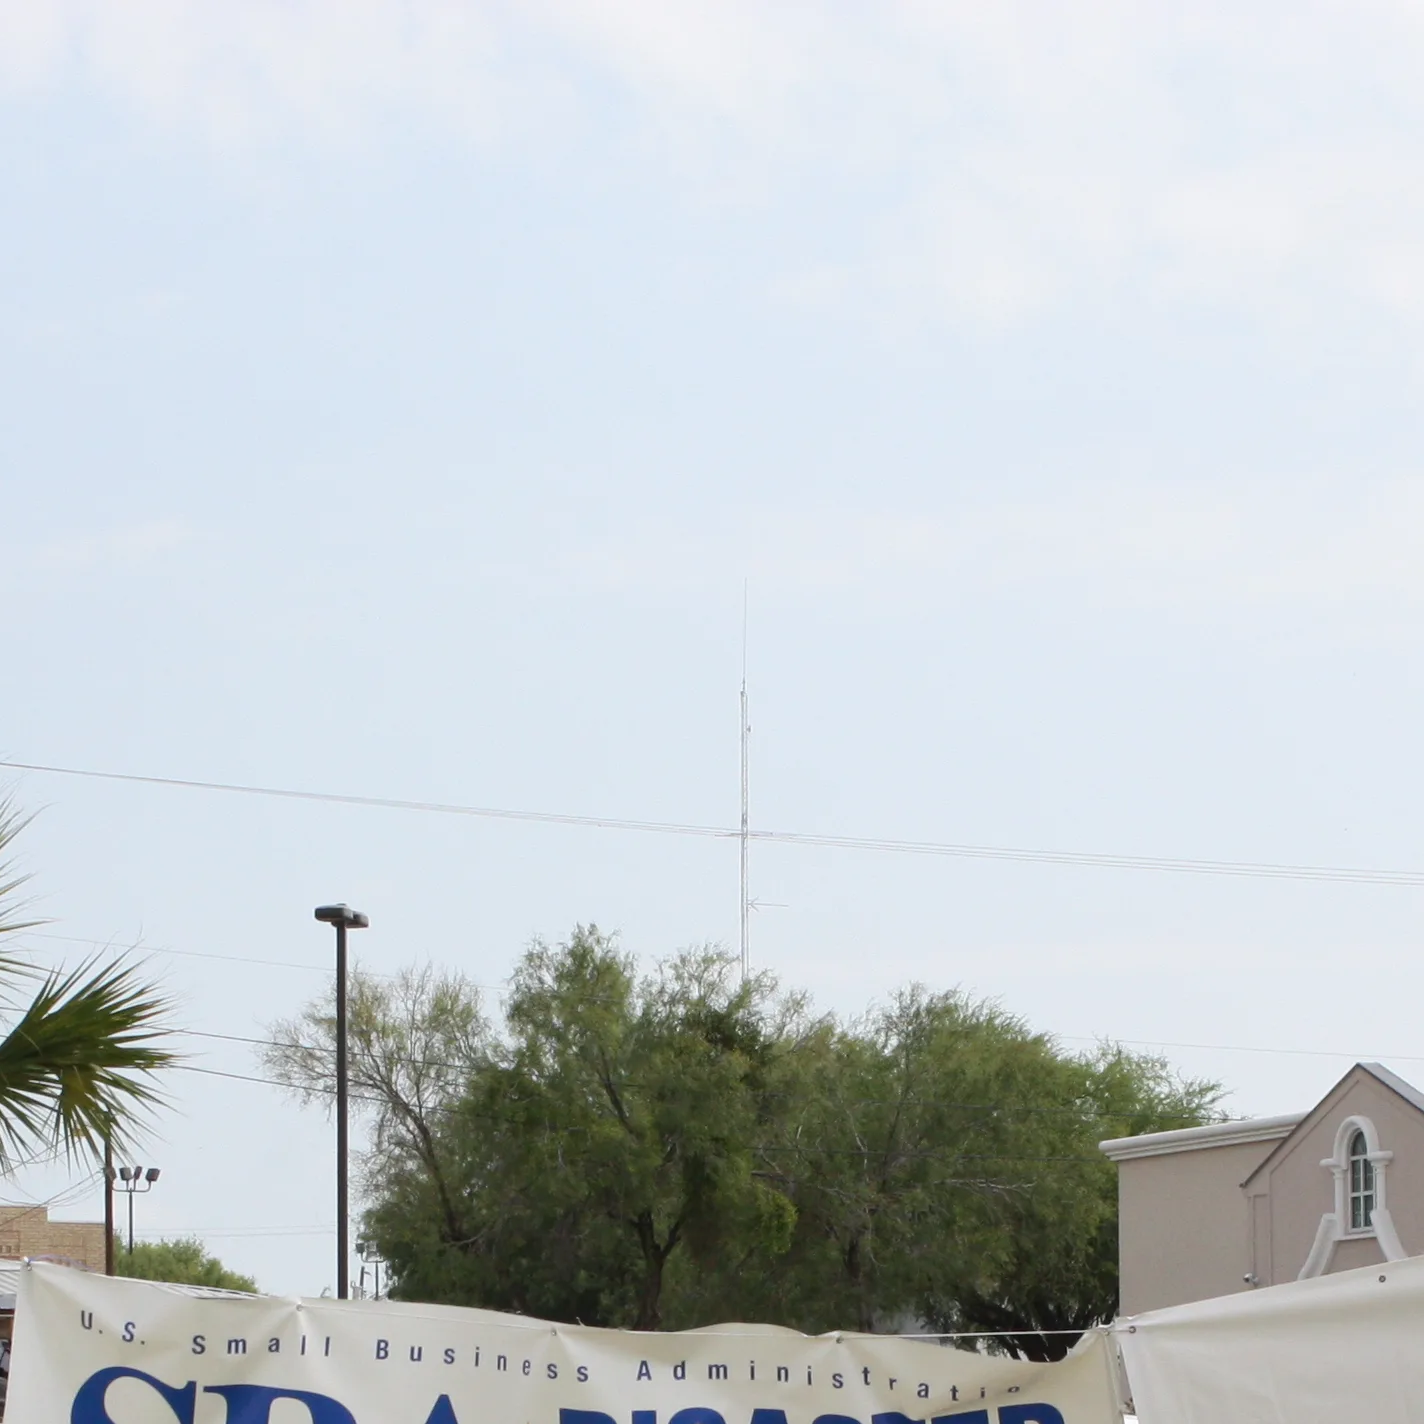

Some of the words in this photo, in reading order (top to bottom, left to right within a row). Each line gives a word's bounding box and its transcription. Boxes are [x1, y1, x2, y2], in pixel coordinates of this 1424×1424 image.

[80, 1310, 145, 1345] U.S.
[191, 1334, 330, 1357] Small
[375, 1339, 589, 1383] Business
[636, 1361, 1019, 1400] Administratio
